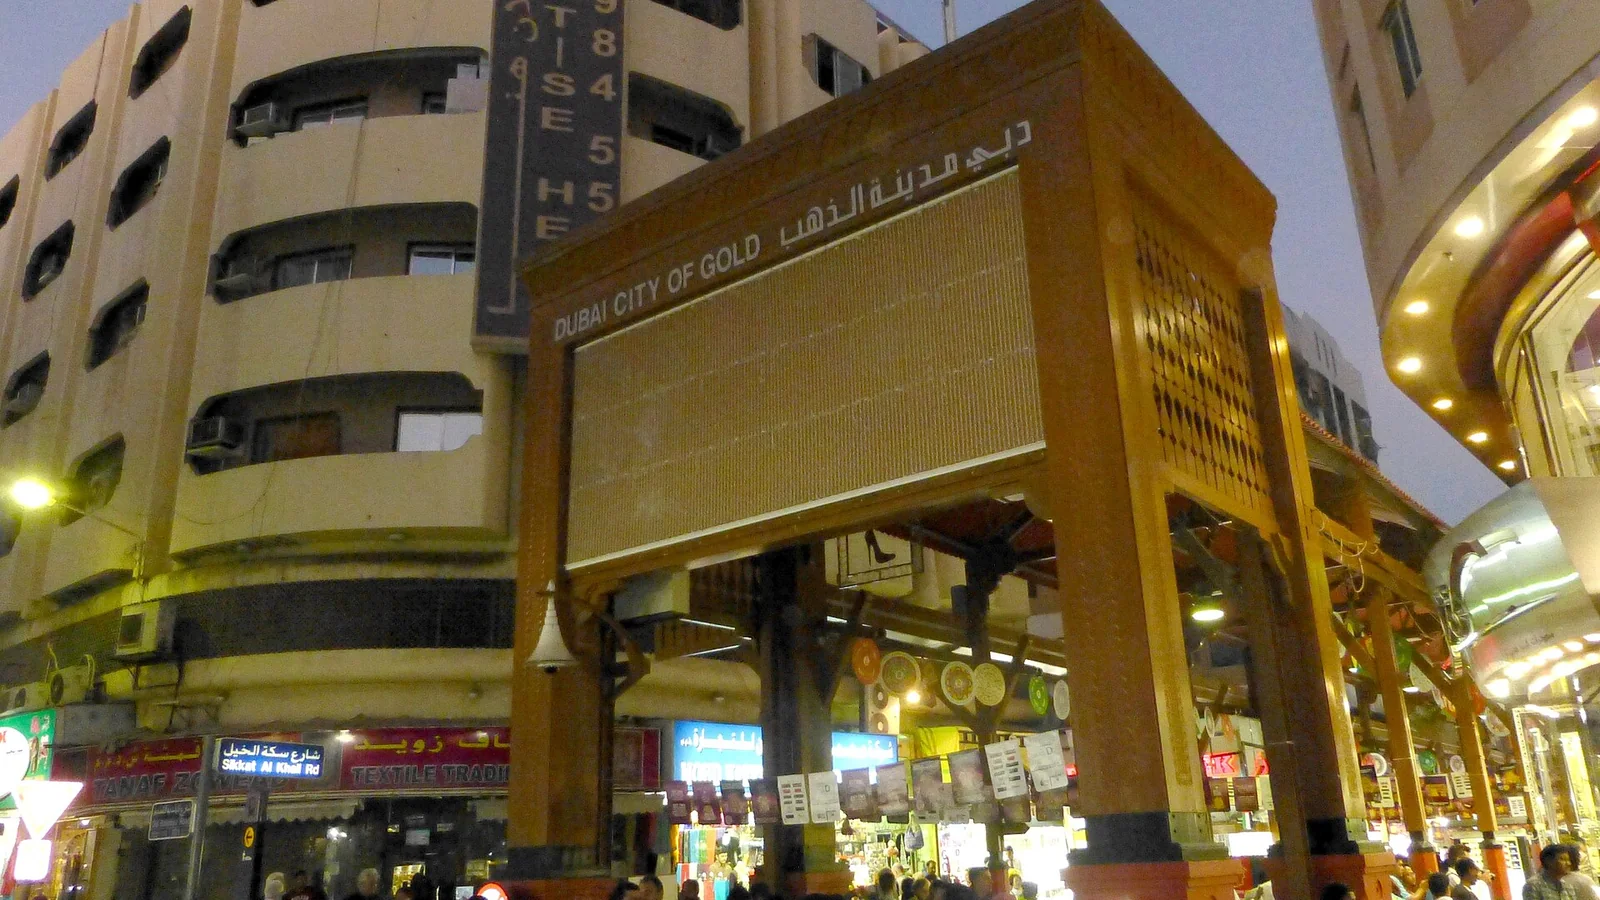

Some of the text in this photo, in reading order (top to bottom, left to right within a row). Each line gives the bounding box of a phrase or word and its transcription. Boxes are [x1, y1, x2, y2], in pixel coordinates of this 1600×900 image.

[780, 120, 1032, 249] دبي مدينة الذهب
[554, 233, 761, 342] DUBAI CITY OF GOLD
[223, 742, 320, 764] شارع سكة الخيل
[222, 758, 257, 773] Sikkat
[261, 760, 273, 774] Al
[305, 763, 320, 776] Rd
[351, 764, 437, 785] TEXTILE
